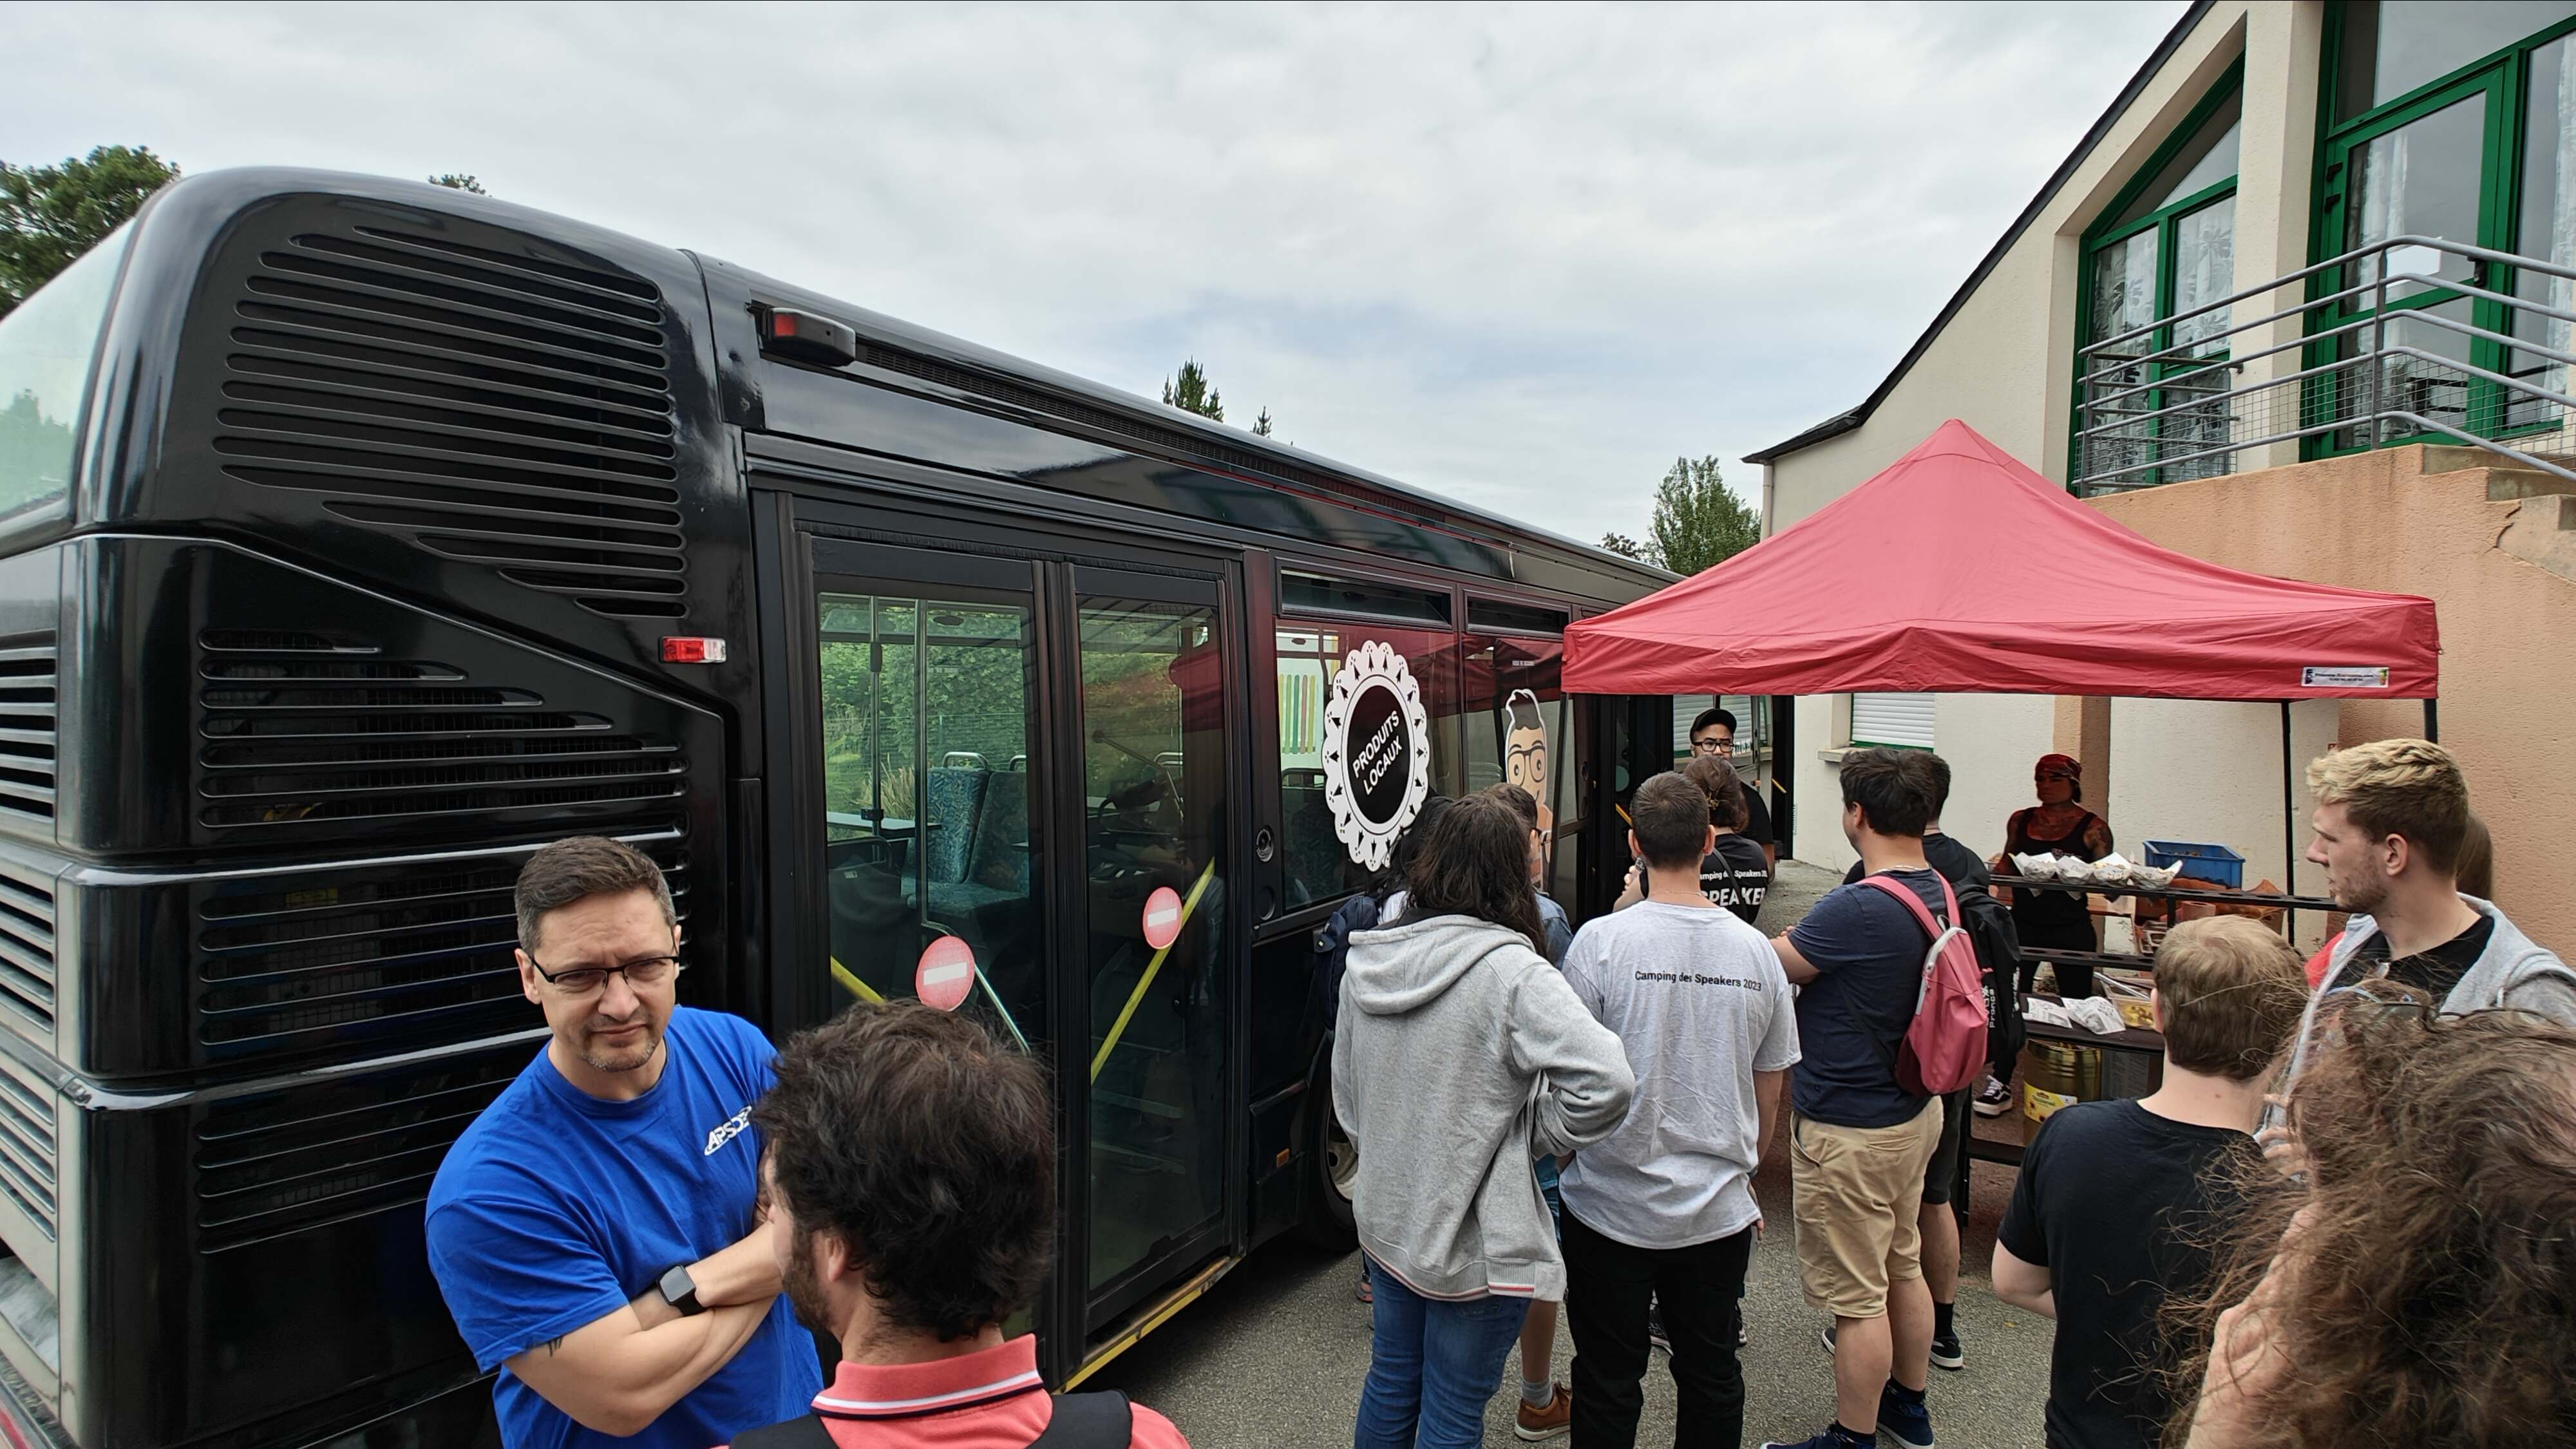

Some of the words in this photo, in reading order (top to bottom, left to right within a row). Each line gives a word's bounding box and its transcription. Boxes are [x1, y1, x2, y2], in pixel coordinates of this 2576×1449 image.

[1352, 710, 1399, 778] PRODUITS
[1363, 735, 1403, 795] LOCAUX
[1635, 971, 1676, 983] Camping
[1679, 972, 1692, 982] des
[1694, 974, 1741, 987] Speakers
[1743, 978, 1762, 992] 2023
